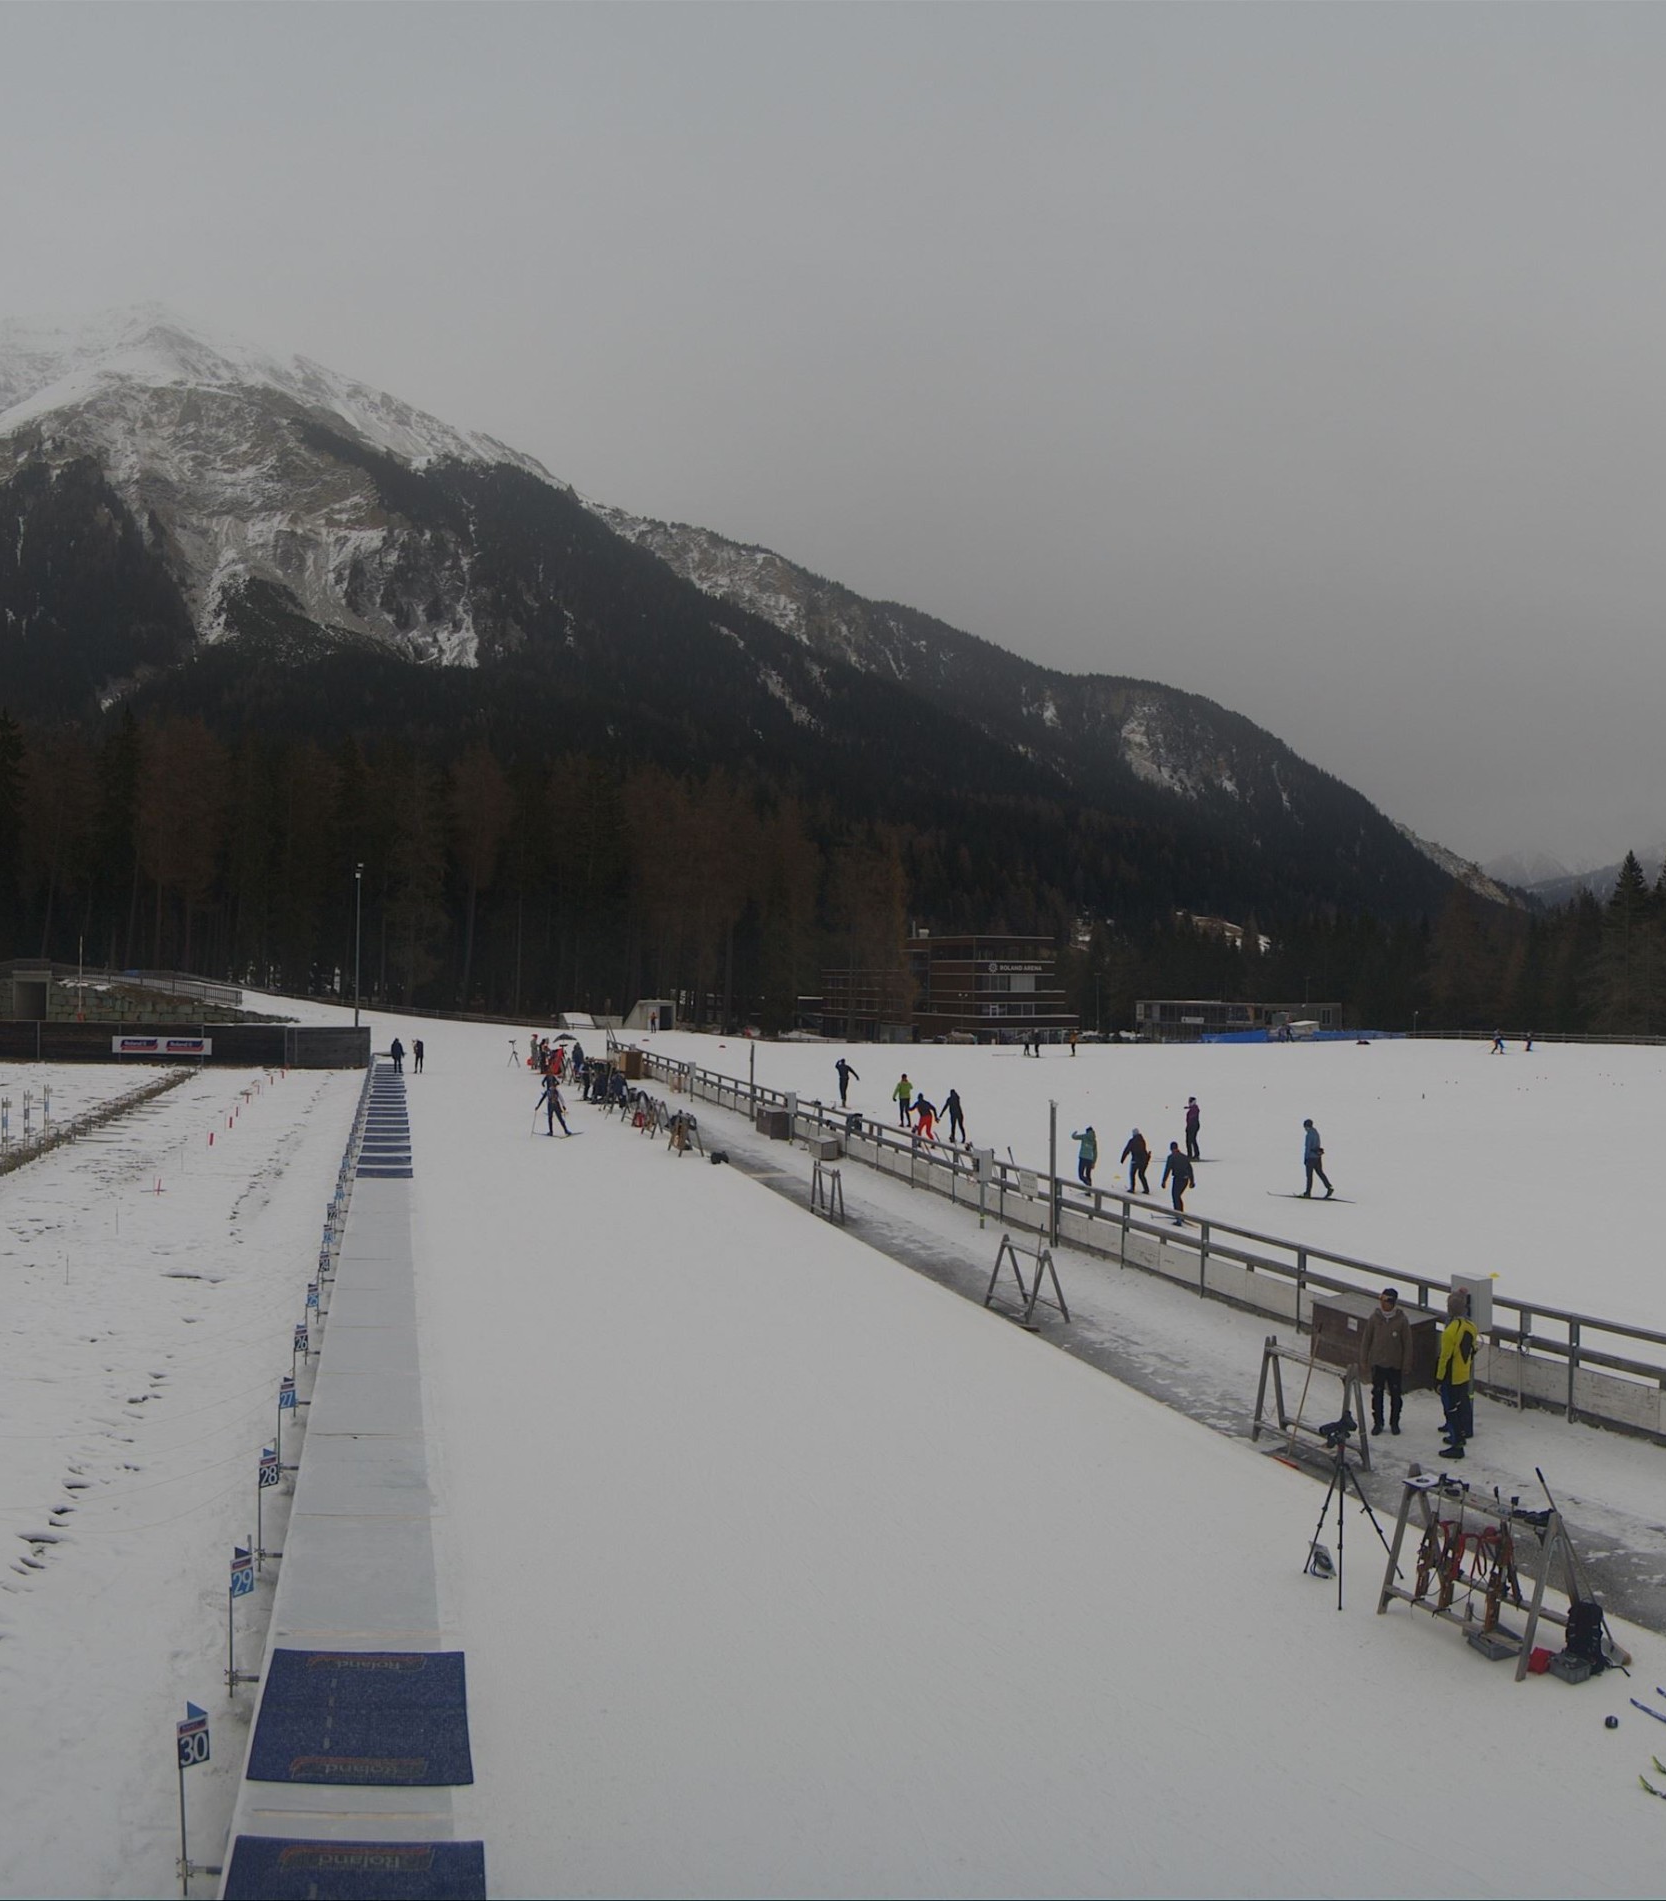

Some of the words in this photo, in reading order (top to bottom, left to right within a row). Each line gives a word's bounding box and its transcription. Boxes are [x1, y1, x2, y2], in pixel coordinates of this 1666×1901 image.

[320, 1259, 329, 1271] 24
[308, 1294, 318, 1306] 25
[295, 1336, 307, 1351] 26
[281, 1391, 294, 1408] 27
[260, 1465, 278, 1486] 28
[233, 1569, 252, 1596] 29
[337, 1660, 401, 1670] Roland
[180, 1732, 208, 1766] 30
[324, 1763, 398, 1774] Roland
[318, 1855, 401, 1868] Roland
